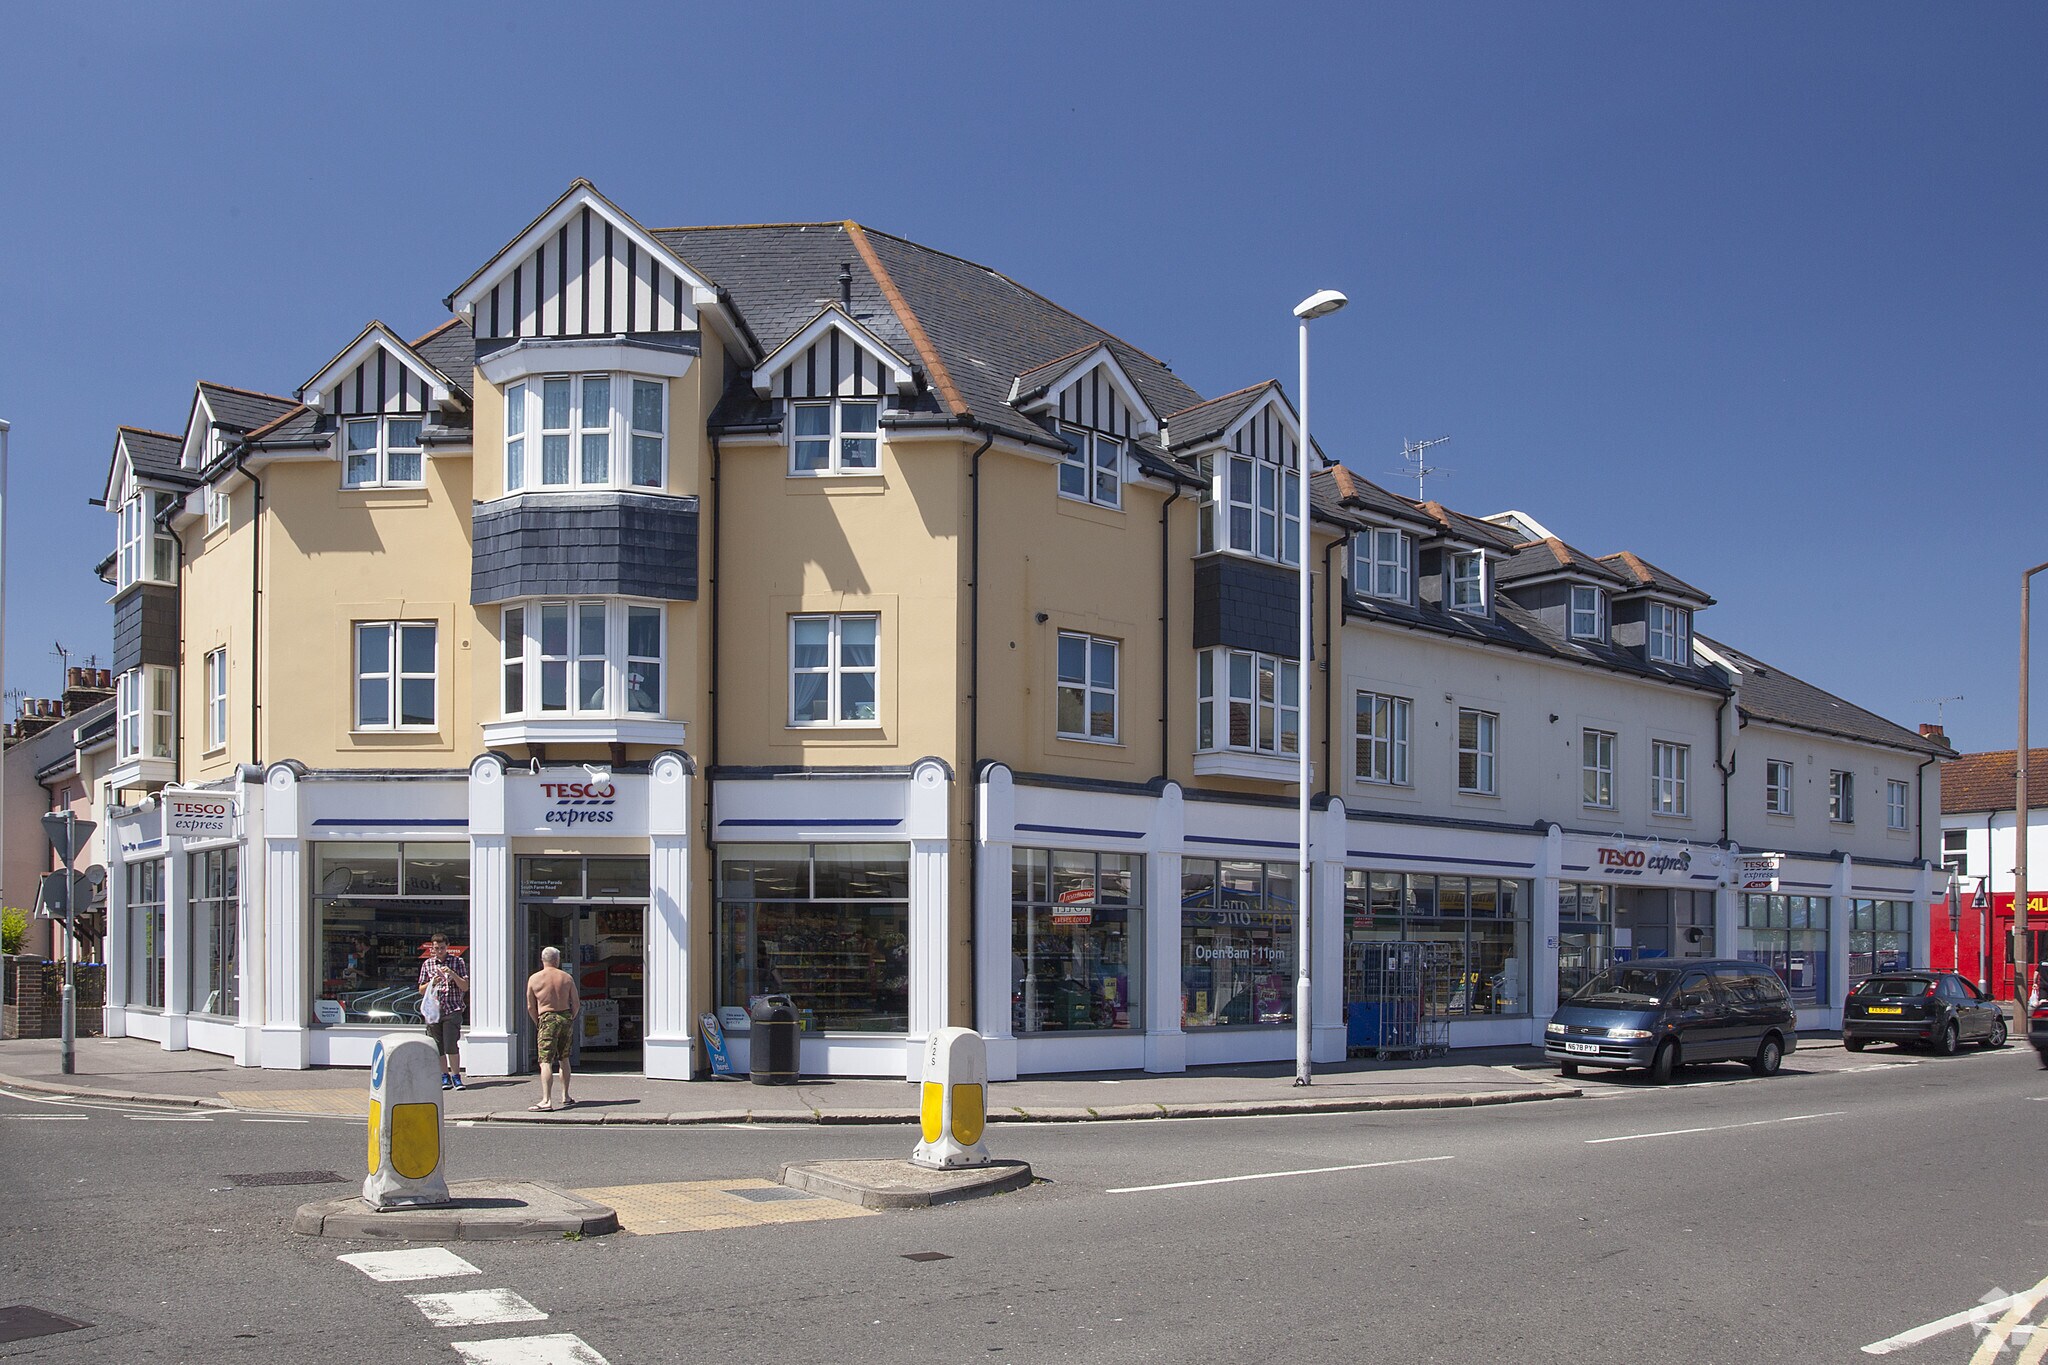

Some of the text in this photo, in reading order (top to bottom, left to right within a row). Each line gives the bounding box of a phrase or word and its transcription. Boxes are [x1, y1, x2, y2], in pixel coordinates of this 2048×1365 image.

[540, 783, 616, 798] TESCO
[173, 802, 225, 814] TESCO
[545, 808, 614, 827] express
[175, 818, 223, 831] express
[1597, 847, 1690, 875] TESCO express
[1744, 871, 1773, 880] express
[1195, 945, 1225, 961] Open
[1227, 946, 1249, 959] 8am
[1258, 946, 1285, 962] 11pm
[1567, 1043, 1584, 1051] N678
[713, 1053, 725, 1062] Play
